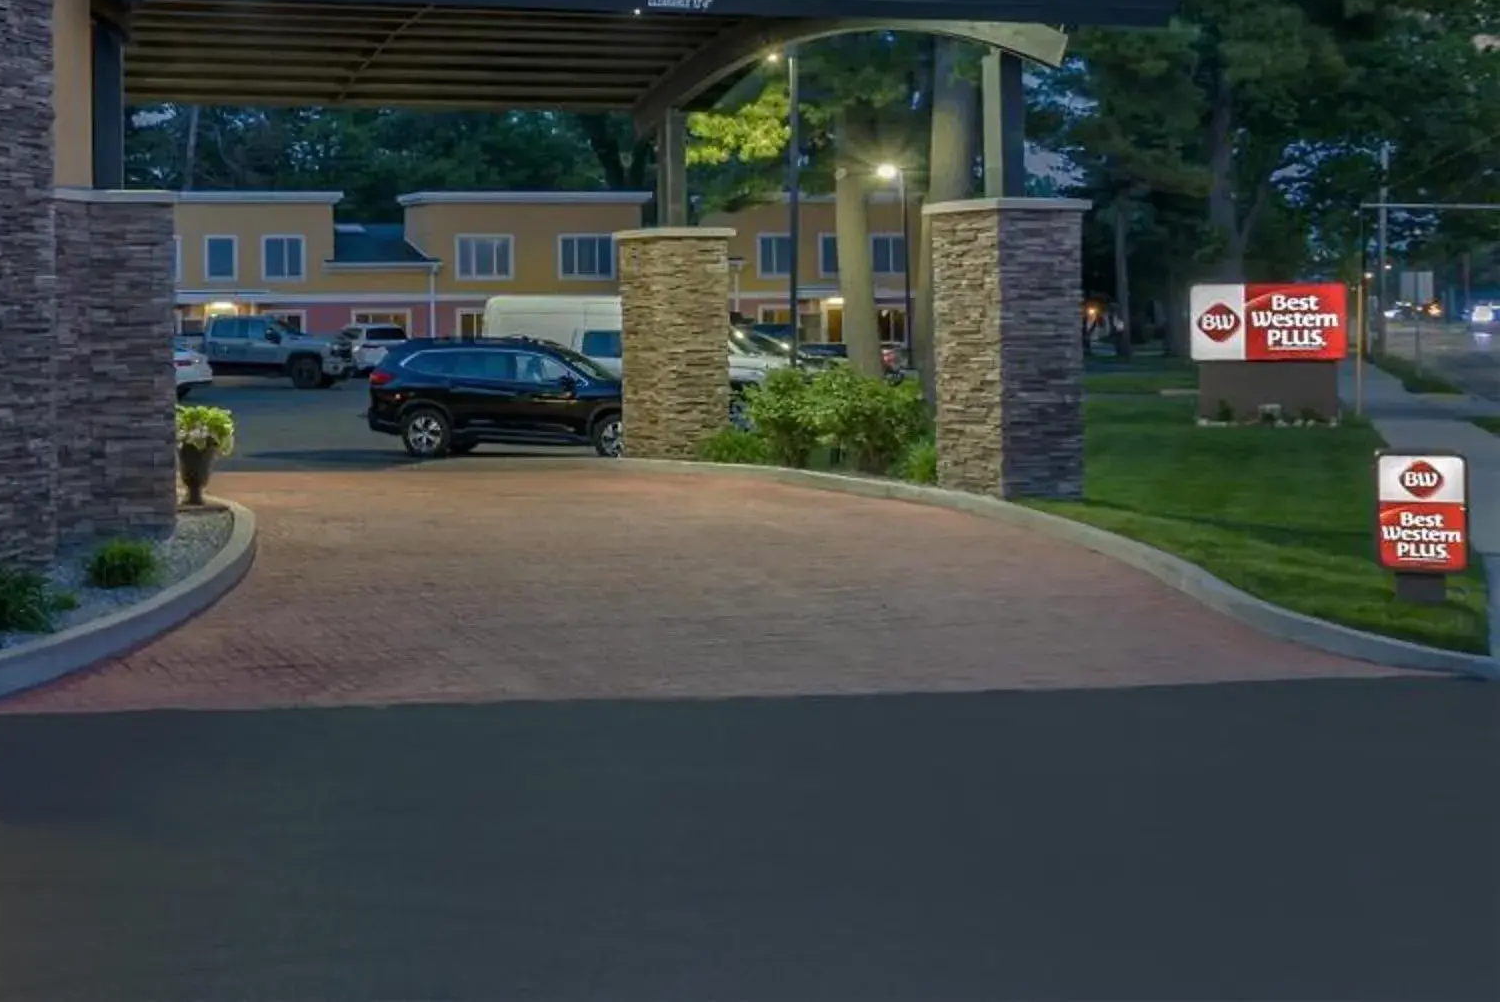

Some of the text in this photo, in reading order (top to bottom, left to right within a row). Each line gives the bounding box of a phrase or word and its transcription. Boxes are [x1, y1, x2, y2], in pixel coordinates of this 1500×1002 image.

[1271, 294, 1319, 311] Best
[1202, 314, 1236, 331] BW
[1251, 311, 1339, 328] Western
[1405, 471, 1438, 487] BW
[1400, 511, 1445, 528] Best
[1381, 525, 1462, 544] Western
